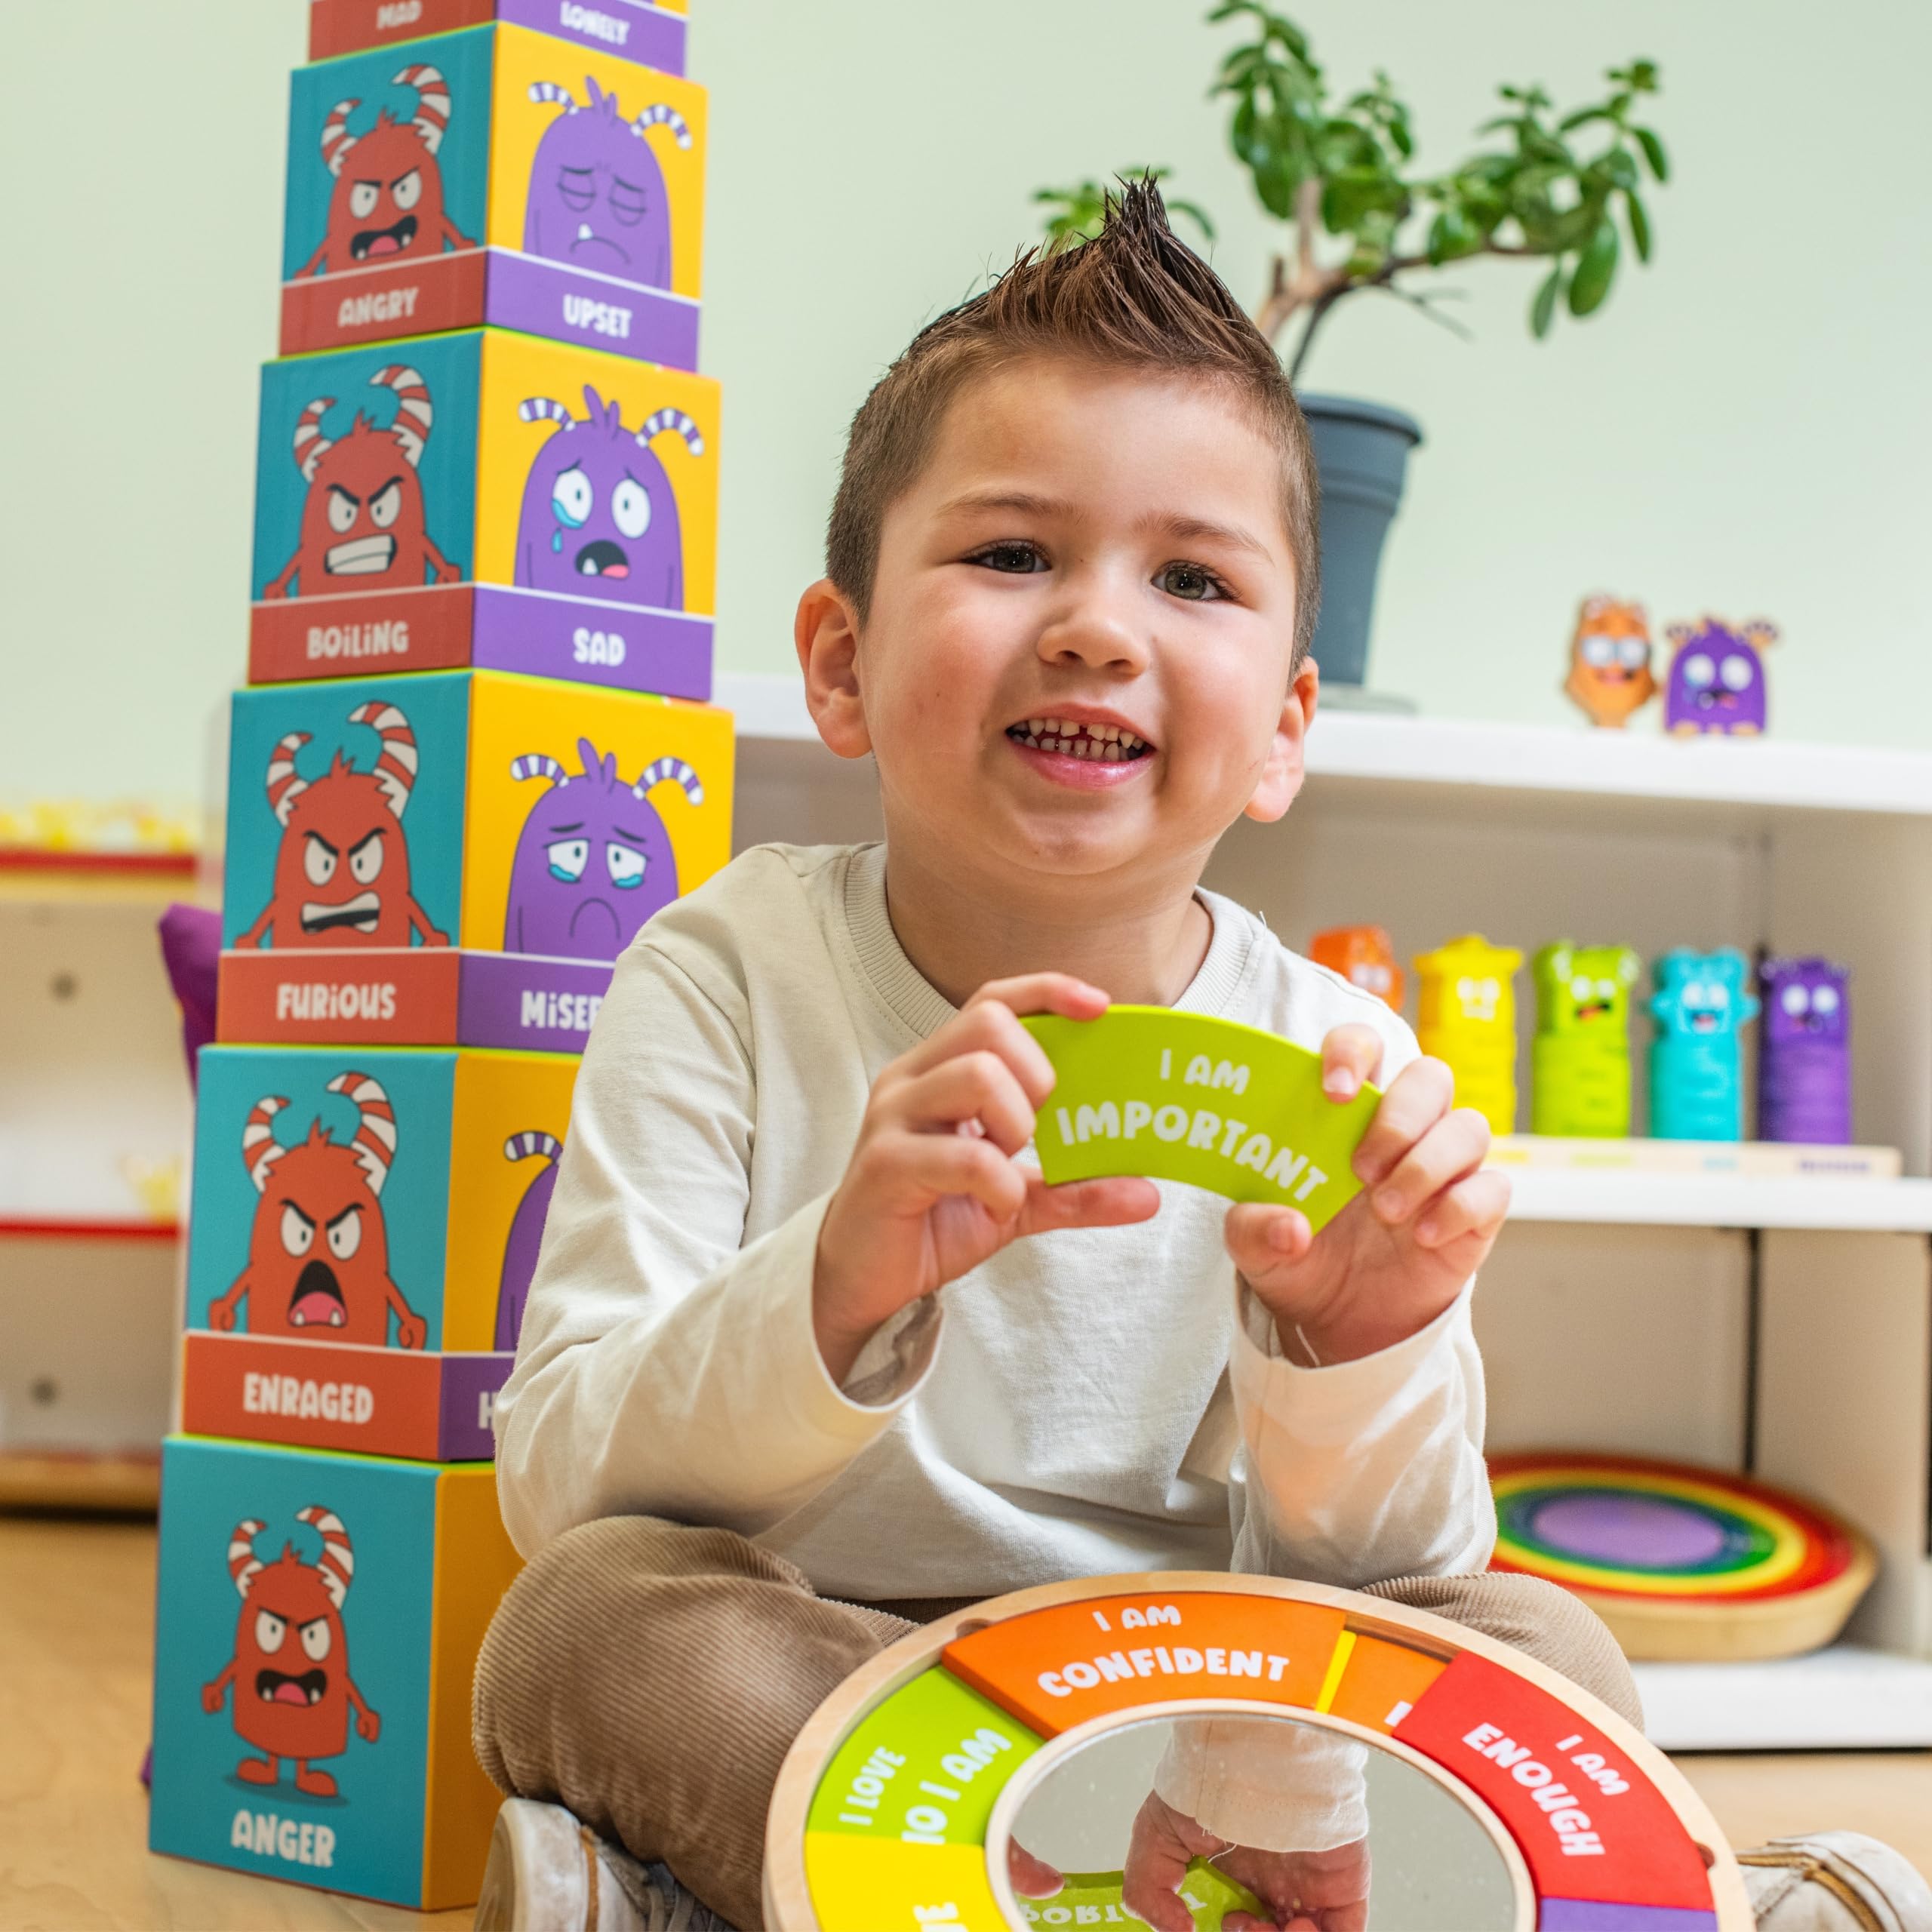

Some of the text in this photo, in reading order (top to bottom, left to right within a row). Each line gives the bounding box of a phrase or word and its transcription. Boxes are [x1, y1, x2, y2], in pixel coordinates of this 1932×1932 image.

[377, 0, 423, 29] MAD
[560, 1, 630, 45] LONELY
[338, 288, 419, 327] ANGRY
[563, 294, 632, 338] UPSET
[573, 628, 626, 666] SAD
[1160, 1048, 1251, 1095] I AM
[1056, 1100, 1328, 1201] IMPORTANT
[243, 1371, 374, 1425] ENRAGED
[1092, 1604, 1182, 1632] I AM
[1038, 1646, 1290, 1697] CONFIDENT
[838, 1746, 906, 1826] I LOVE
[918, 1780, 961, 1801] I
[940, 1727, 1012, 1783] AM
[1462, 1722, 1606, 1857] ENOUGH
[1555, 1734, 1630, 1796] I AM
[230, 1808, 336, 1868] ANGER
